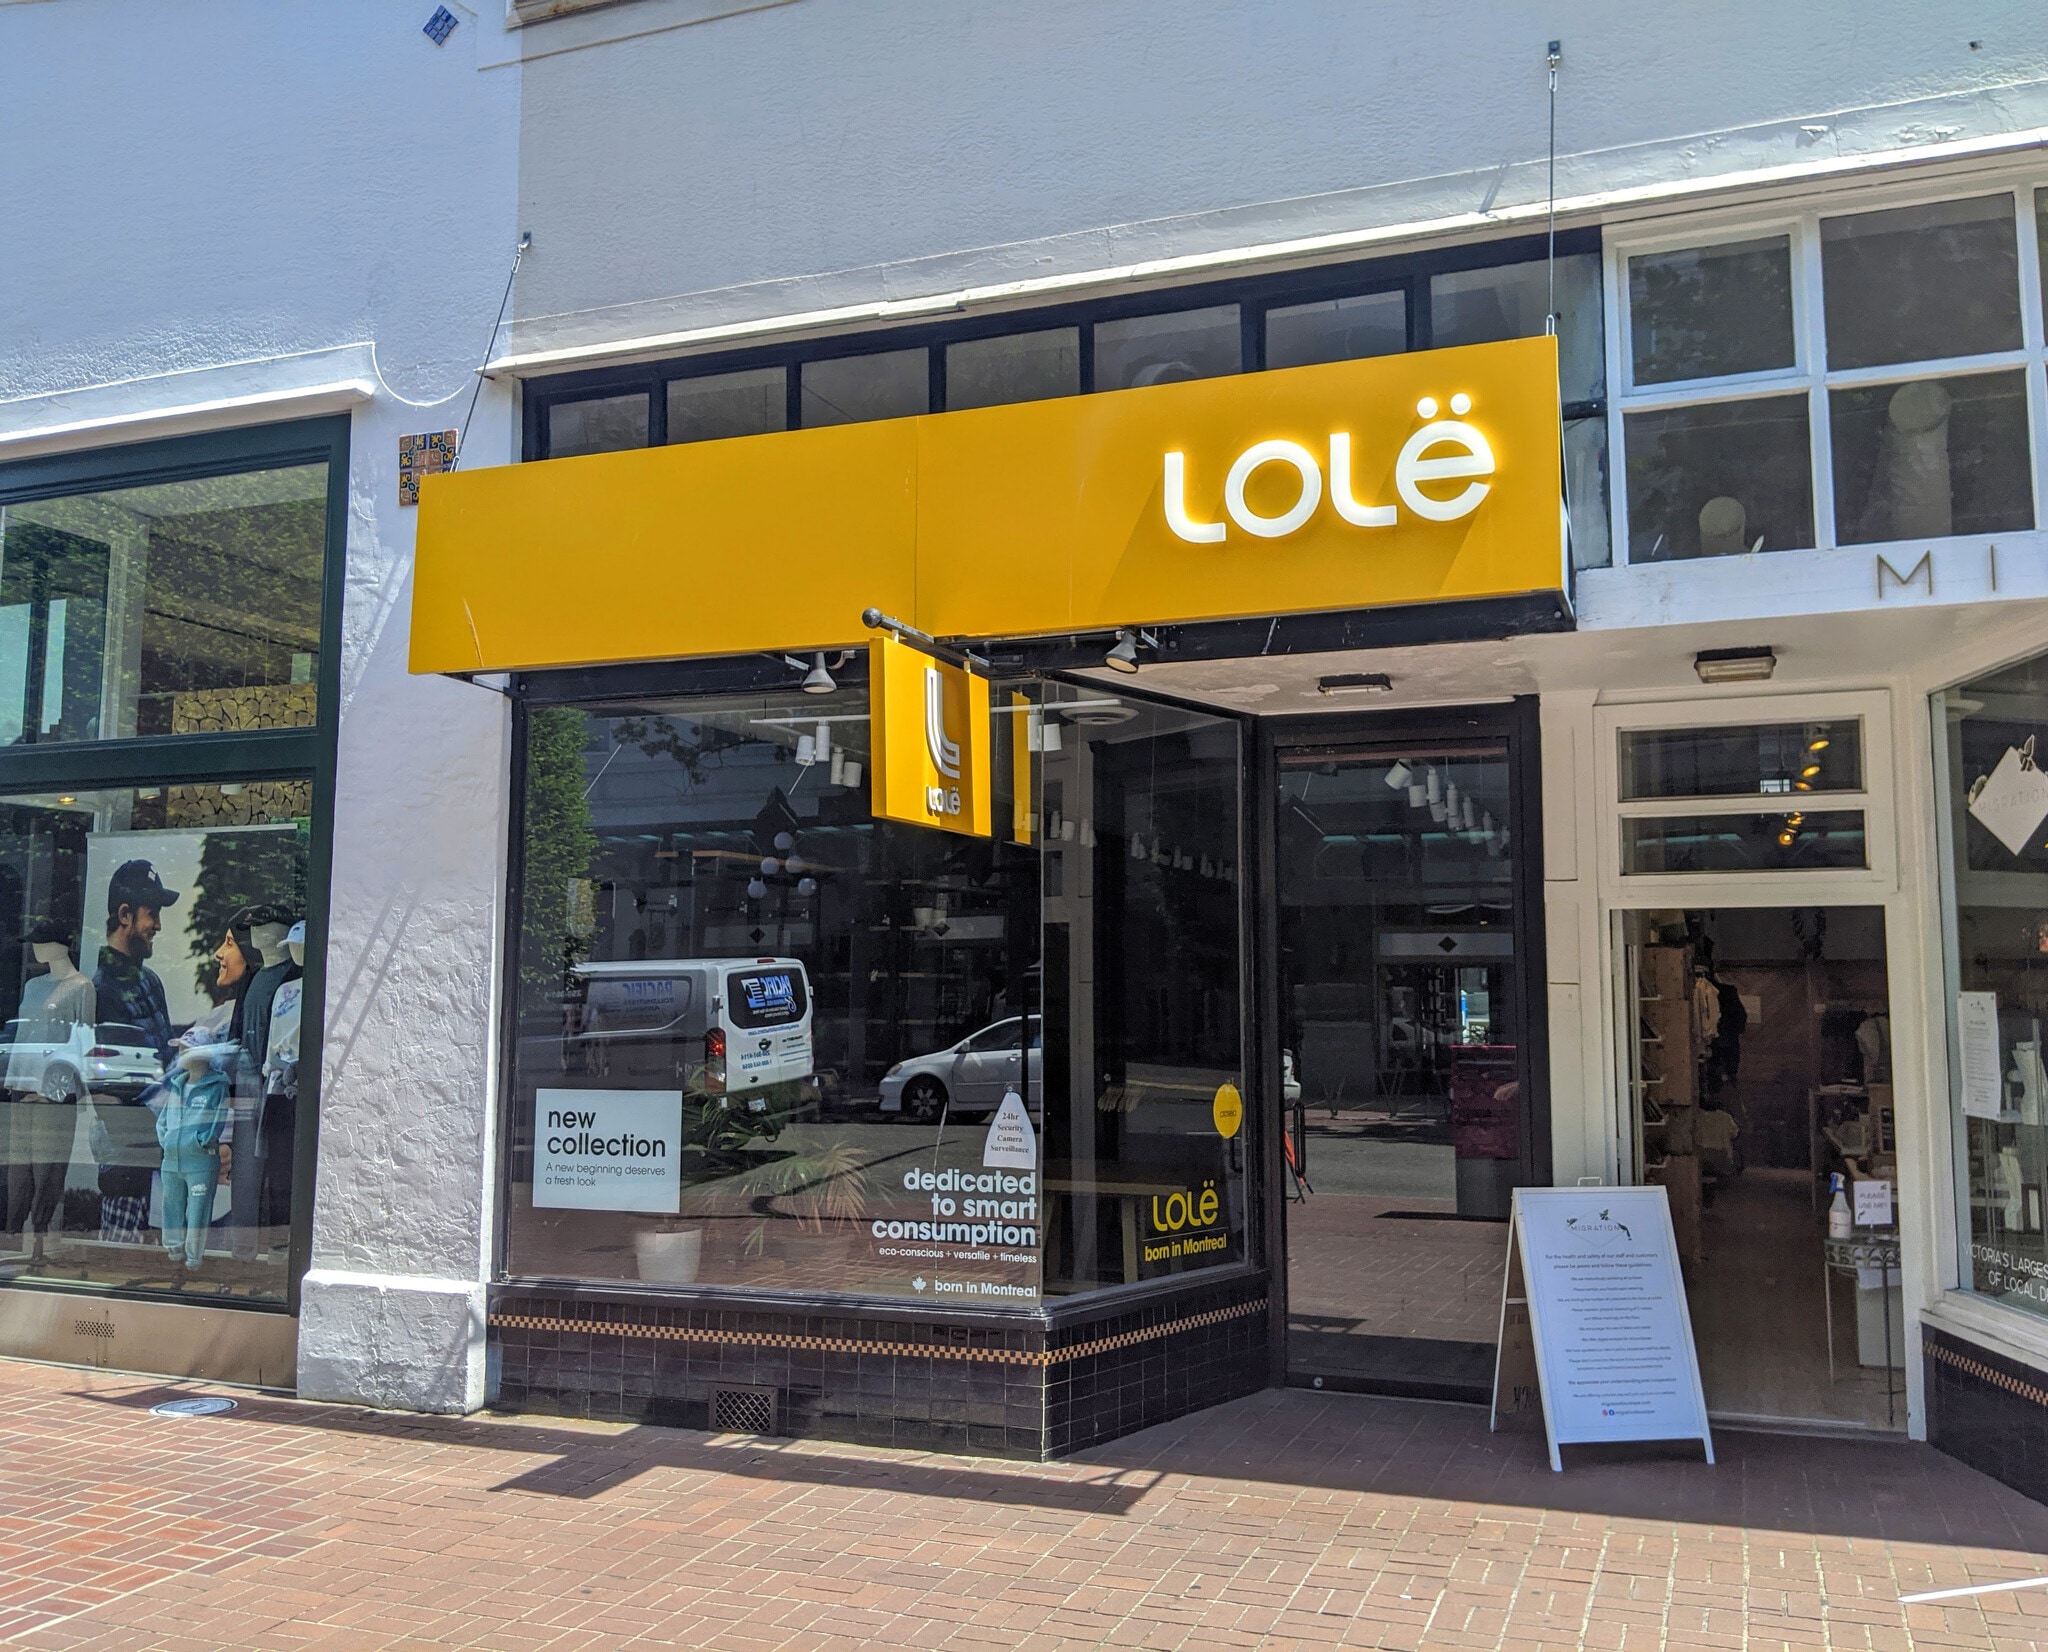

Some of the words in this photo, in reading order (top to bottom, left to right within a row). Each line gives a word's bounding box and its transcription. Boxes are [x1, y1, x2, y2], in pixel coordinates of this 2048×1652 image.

[548, 1110, 596, 1128] new
[1002, 1112, 1019, 1121] 24hr
[997, 1124, 1023, 1134] Security
[547, 1132, 666, 1157] collection
[997, 1134, 1023, 1143] Camera
[990, 1144, 1029, 1154] Surveillance
[545, 1162, 553, 1172] A
[555, 1164, 574, 1172] new
[577, 1163, 622, 1176] beginning
[625, 1165, 665, 1176] deserves
[545, 1176, 552, 1185] a
[554, 1175, 575, 1185] fresh
[577, 1176, 596, 1186] look
[903, 1167, 1036, 1195] dedicated
[931, 1193, 956, 1216] to
[963, 1196, 1037, 1220] smart
[871, 1219, 1036, 1248] consumption
[1570, 1223, 1620, 1232] MIGRATION
[879, 1246, 943, 1259] eco-conscious
[953, 1250, 990, 1261] versatile
[1000, 1252, 1037, 1264] timeless
[1145, 1246, 1169, 1262] born
[1171, 1241, 1182, 1257] in
[1183, 1233, 1227, 1255] Montreal
[1962, 1242, 2010, 1268] VICTORIA'S
[935, 1279, 963, 1293] born
[966, 1281, 977, 1294] in
[981, 1282, 1037, 1298] Montreal
[1988, 1270, 2002, 1286] OF
[2003, 1274, 2038, 1300] LOCAL
